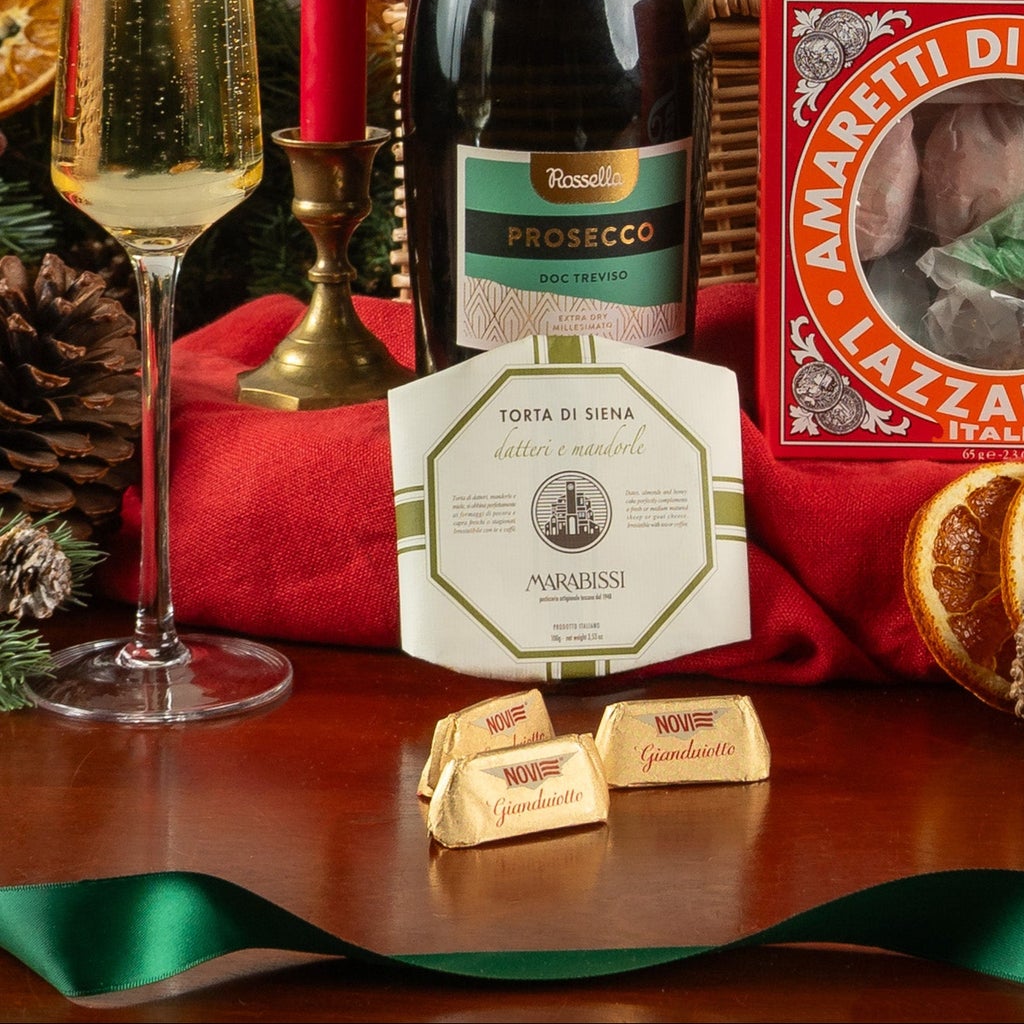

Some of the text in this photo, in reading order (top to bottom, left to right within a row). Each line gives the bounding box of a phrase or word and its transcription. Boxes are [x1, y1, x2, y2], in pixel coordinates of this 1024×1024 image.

[802, 40, 948, 273] AMARETTI
[966, 27, 1020, 68] DI
[546, 165, 624, 189] Rossella
[507, 221, 655, 248] PROSECCO
[540, 270, 628, 284] DOC TREVISO
[558, 313, 609, 322] EXTRA DRY
[499, 406, 635, 423] TORTA DI SIENA
[493, 424, 647, 461] datteri e mandorle
[962, 448, 976, 460] 65
[525, 570, 625, 593] MARABISSI
[486, 709, 515, 736] NOVI
[654, 713, 695, 734] NOVI
[634, 738, 736, 773] Gianduiotto
[503, 762, 544, 787] NOVI
[486, 788, 584, 828] Gianduiotto
